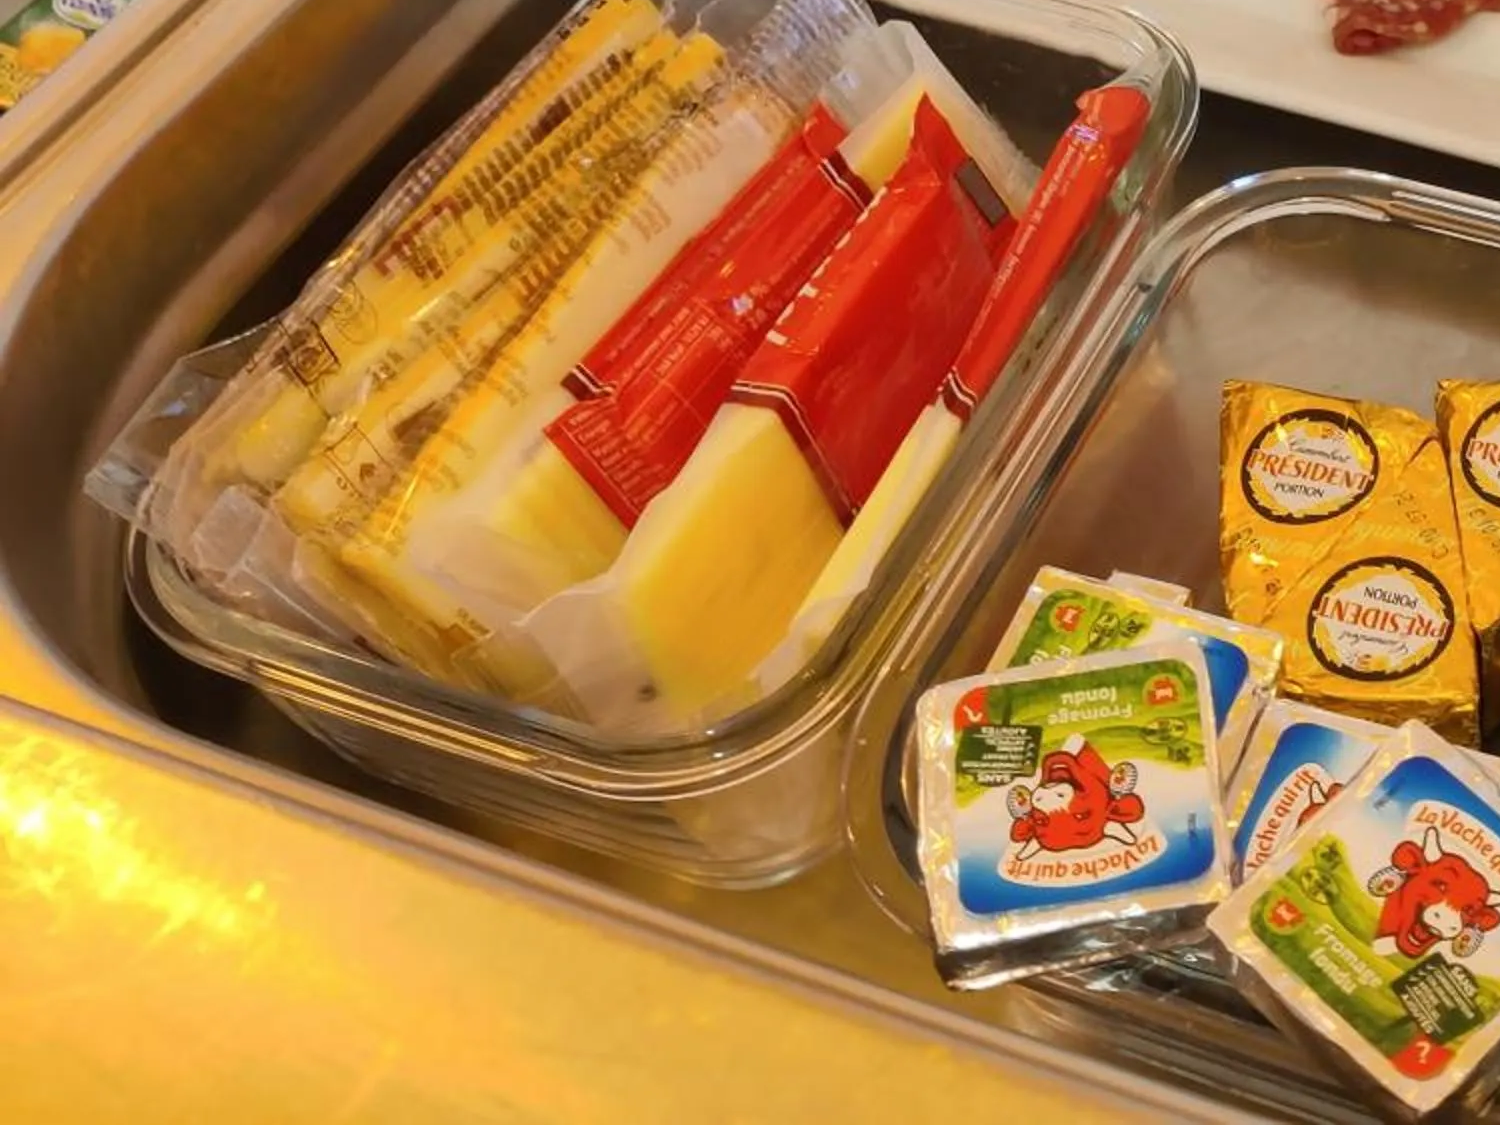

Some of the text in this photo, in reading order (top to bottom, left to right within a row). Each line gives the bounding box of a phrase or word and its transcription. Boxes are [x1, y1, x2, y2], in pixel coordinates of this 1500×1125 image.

[1249, 449, 1375, 492] PRÉSIDENT
[1272, 481, 1326, 499] PORTION
[1363, 585, 1421, 610] PORTION
[1060, 687, 1118, 705] fondu
[1047, 704, 1134, 726] Fromage
[1274, 792, 1297, 823] qui
[1292, 768, 1316, 799] rit
[1413, 805, 1438, 826] La
[1437, 809, 1493, 858] Vache
[1005, 859, 1034, 878] rit
[1034, 860, 1071, 883] qui
[1072, 846, 1141, 878] Vache
[1312, 922, 1385, 990] Fromage
[1306, 947, 1358, 996] fondu
